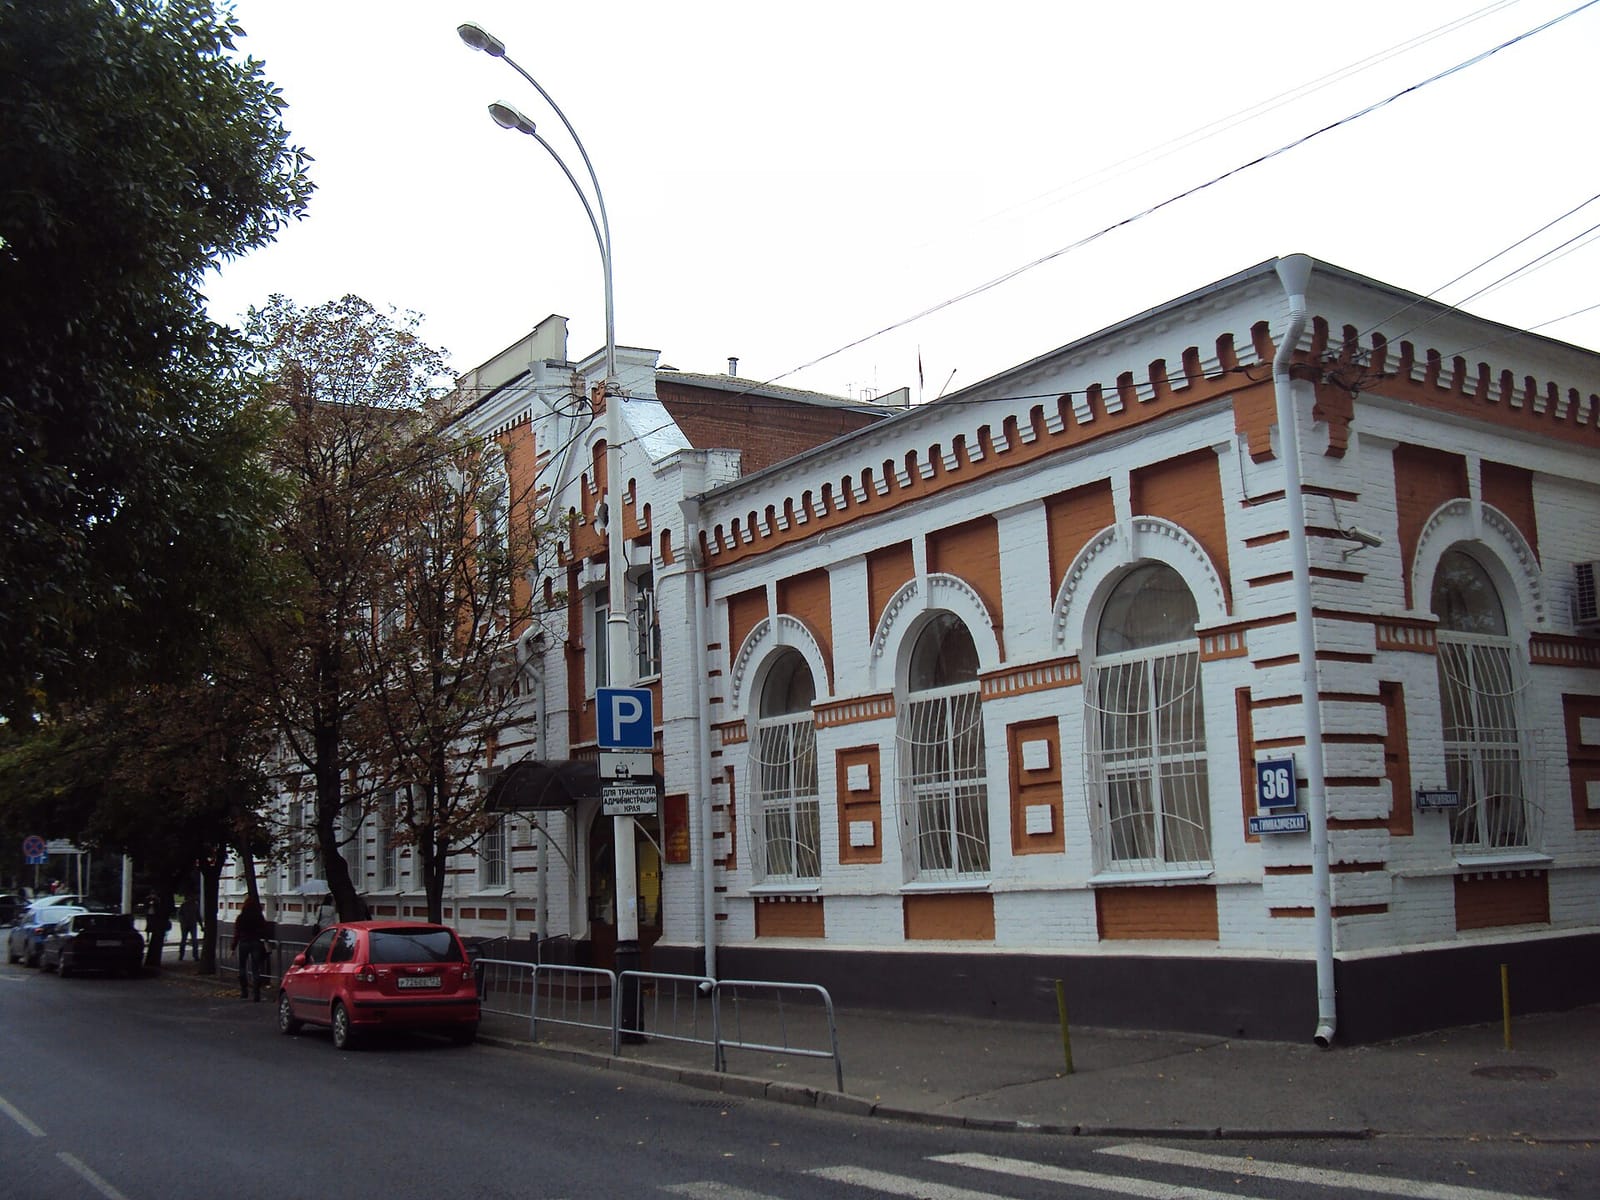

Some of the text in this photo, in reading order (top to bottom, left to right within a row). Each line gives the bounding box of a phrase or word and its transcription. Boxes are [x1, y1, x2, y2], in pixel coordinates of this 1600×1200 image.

[612, 695, 643, 741] P
[1262, 768, 1290, 800] 36
[603, 787, 656, 797] ДЛЯ ТРАНСПОРТА
[603, 796, 657, 806] АДМИНИСТРАЦИИ
[624, 805, 641, 813] КРАЯ
